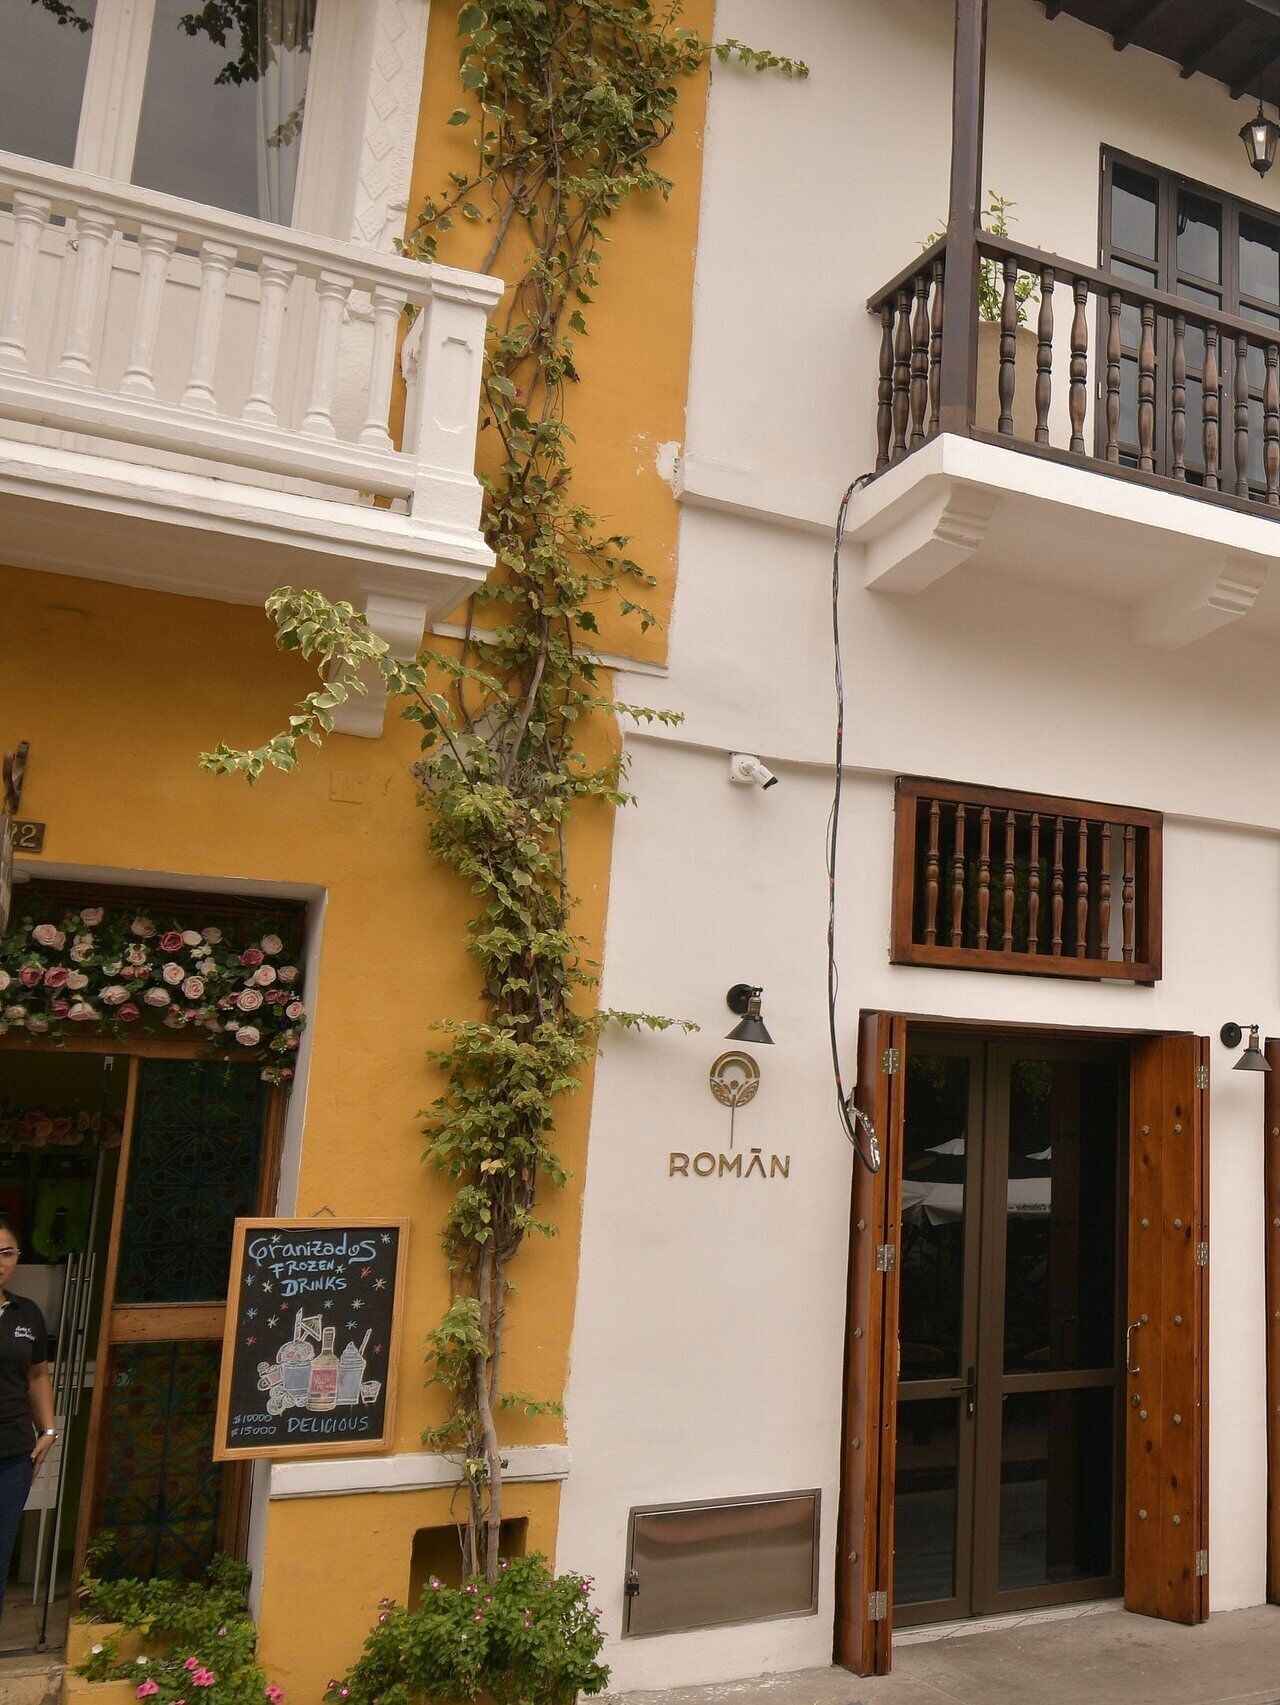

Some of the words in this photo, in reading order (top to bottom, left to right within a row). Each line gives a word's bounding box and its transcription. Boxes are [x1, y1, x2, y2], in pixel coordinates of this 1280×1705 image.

[248, 1232, 377, 1267] Granizados
[268, 1260, 335, 1279] FROZEN
[280, 1277, 348, 1297] DRINKS
[287, 1416, 370, 1434] DELICIOUS
